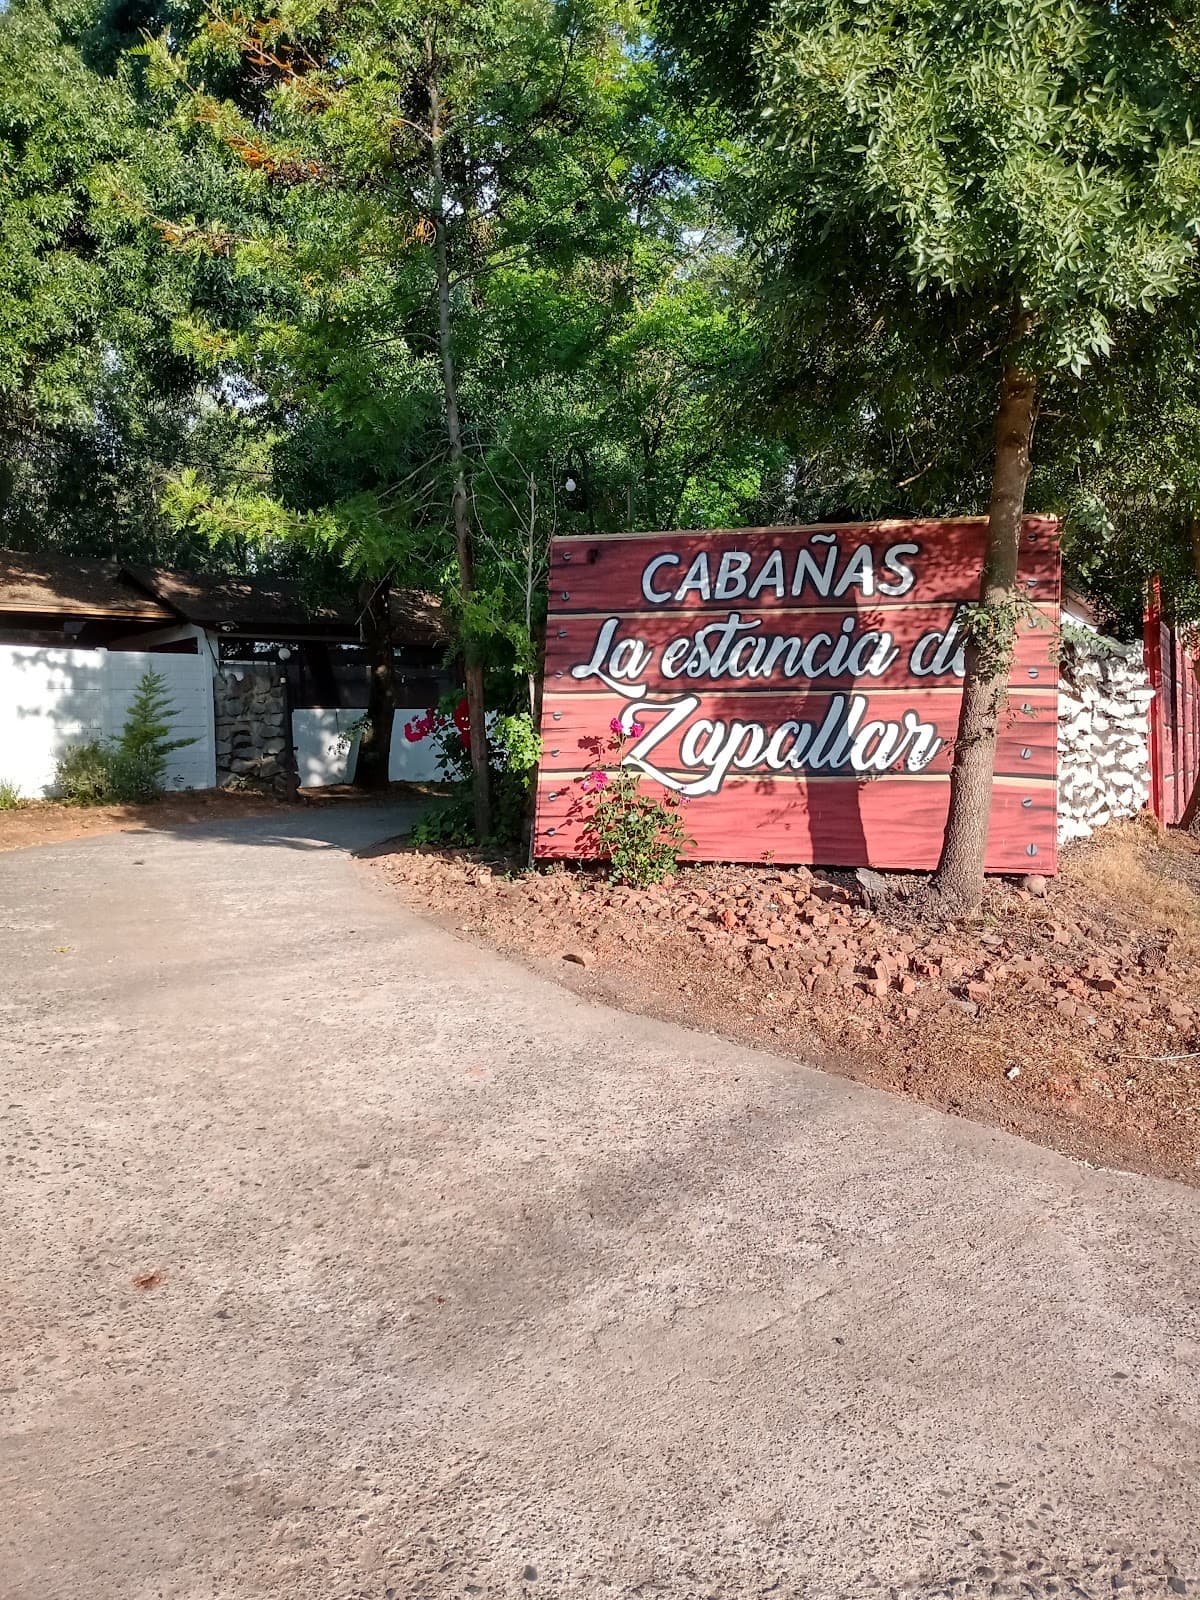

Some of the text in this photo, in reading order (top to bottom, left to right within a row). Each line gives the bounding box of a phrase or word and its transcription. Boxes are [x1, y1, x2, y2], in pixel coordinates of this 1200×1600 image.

[642, 535, 919, 602] CABAÑAS
[572, 618, 652, 697] La
[661, 613, 899, 679] estancia
[620, 694, 943, 795] Zapallar
